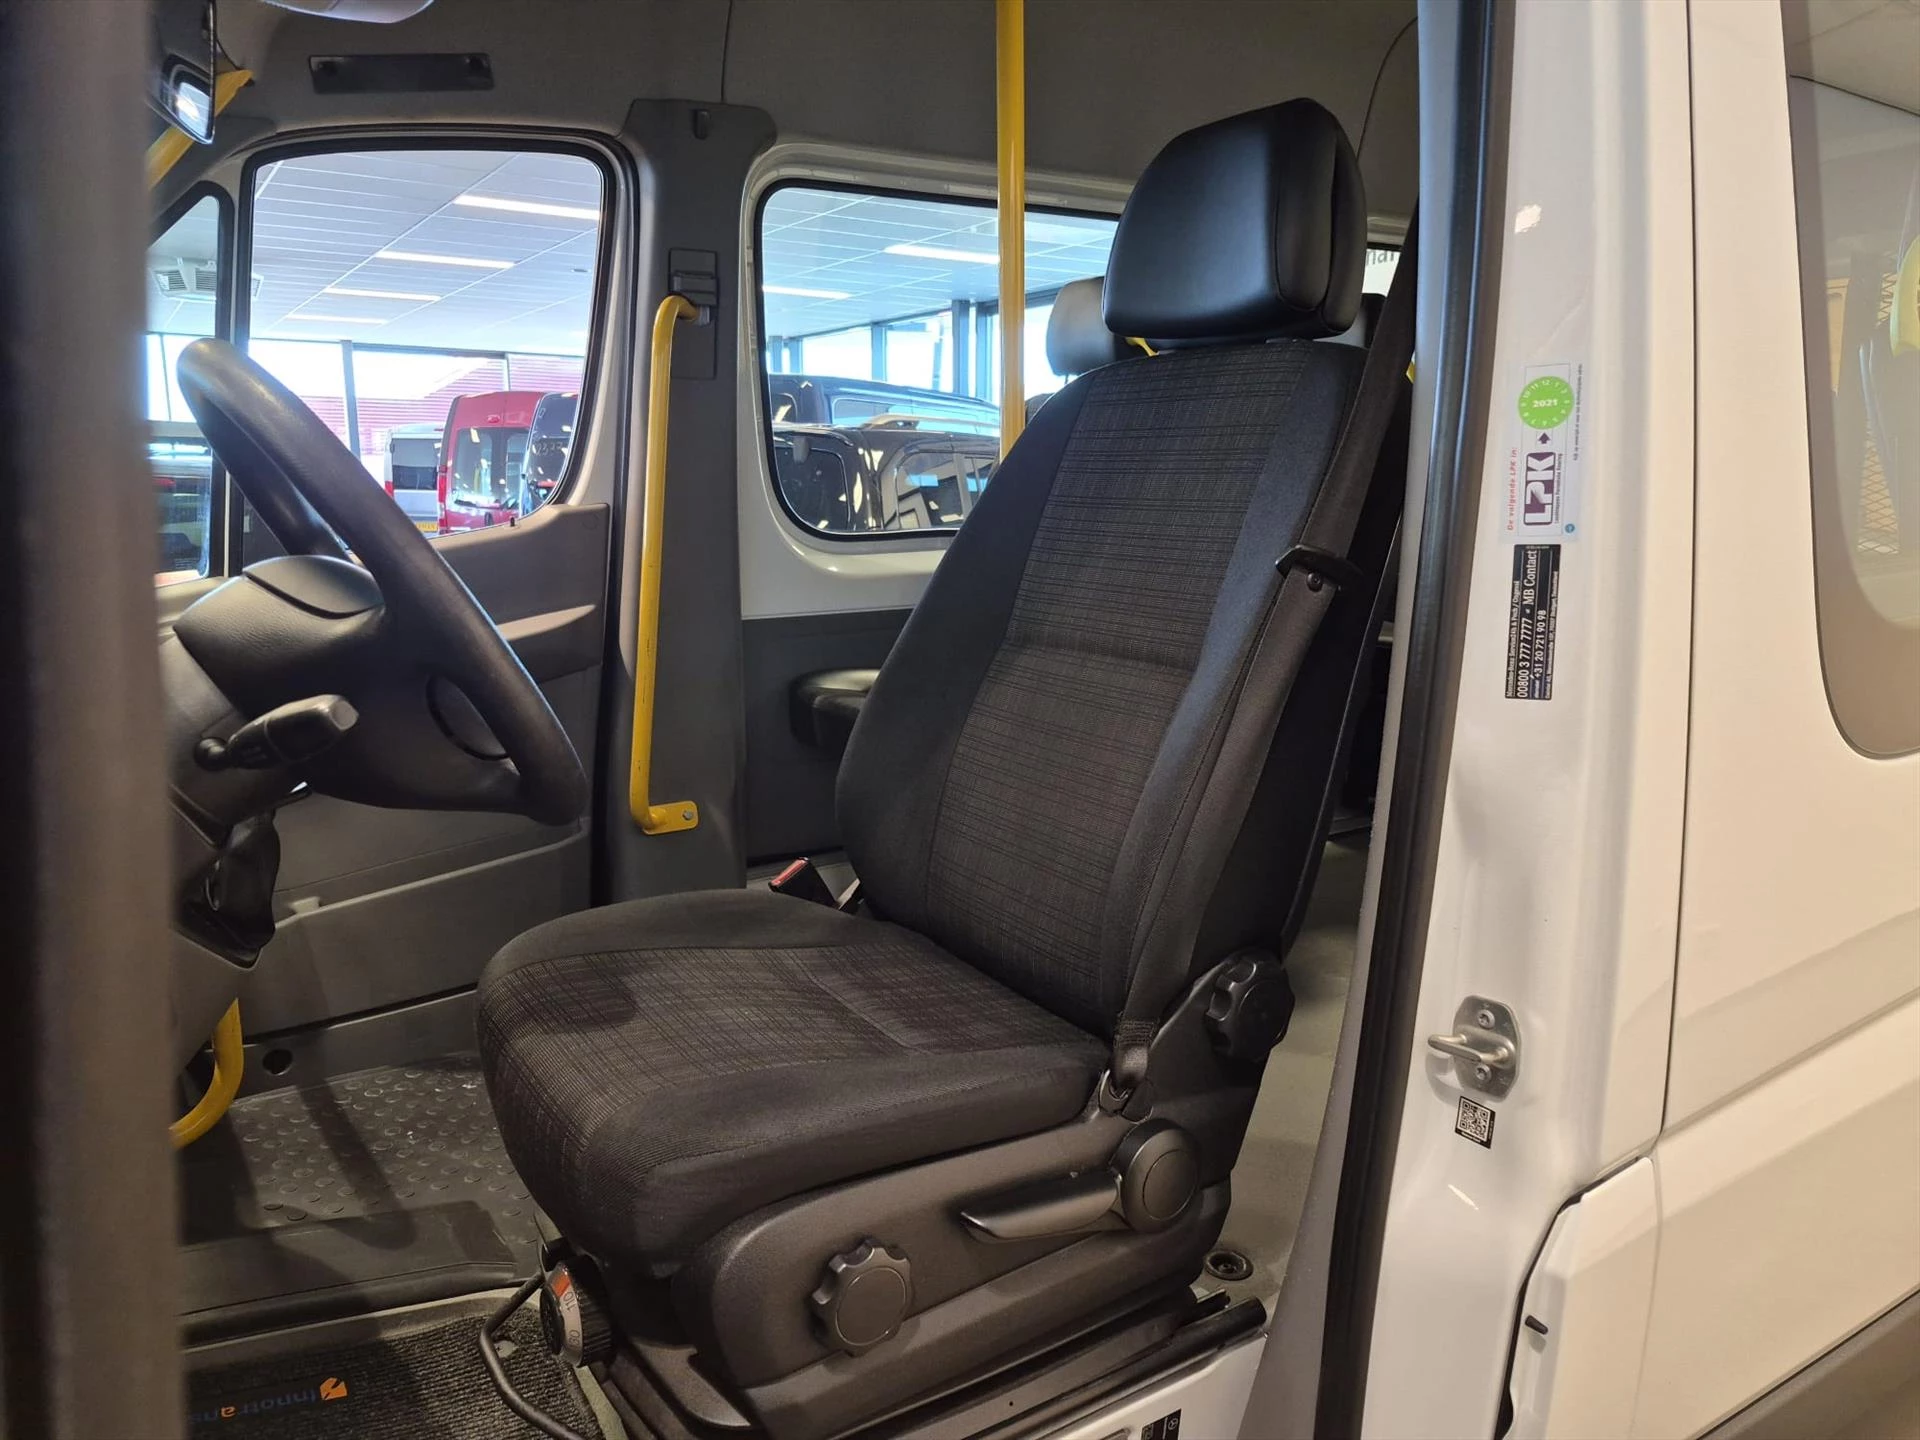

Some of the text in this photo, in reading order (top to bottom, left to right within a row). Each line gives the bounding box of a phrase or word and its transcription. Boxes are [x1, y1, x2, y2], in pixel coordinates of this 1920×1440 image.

[1509, 460, 1517, 476] LPK
[1524, 454, 1555, 524] LPK
[1523, 550, 1537, 587] Contact
[1522, 588, 1535, 605] MB
[1537, 609, 1547, 621] 98
[1520, 617, 1532, 641] 7777
[1536, 621, 1546, 633] 90
[1535, 635, 1545, 650] 721
[1519, 642, 1531, 660] 777
[1535, 650, 1544, 662] 20
[1534, 663, 1543, 678] +31
[1516, 669, 1529, 698] 00800
